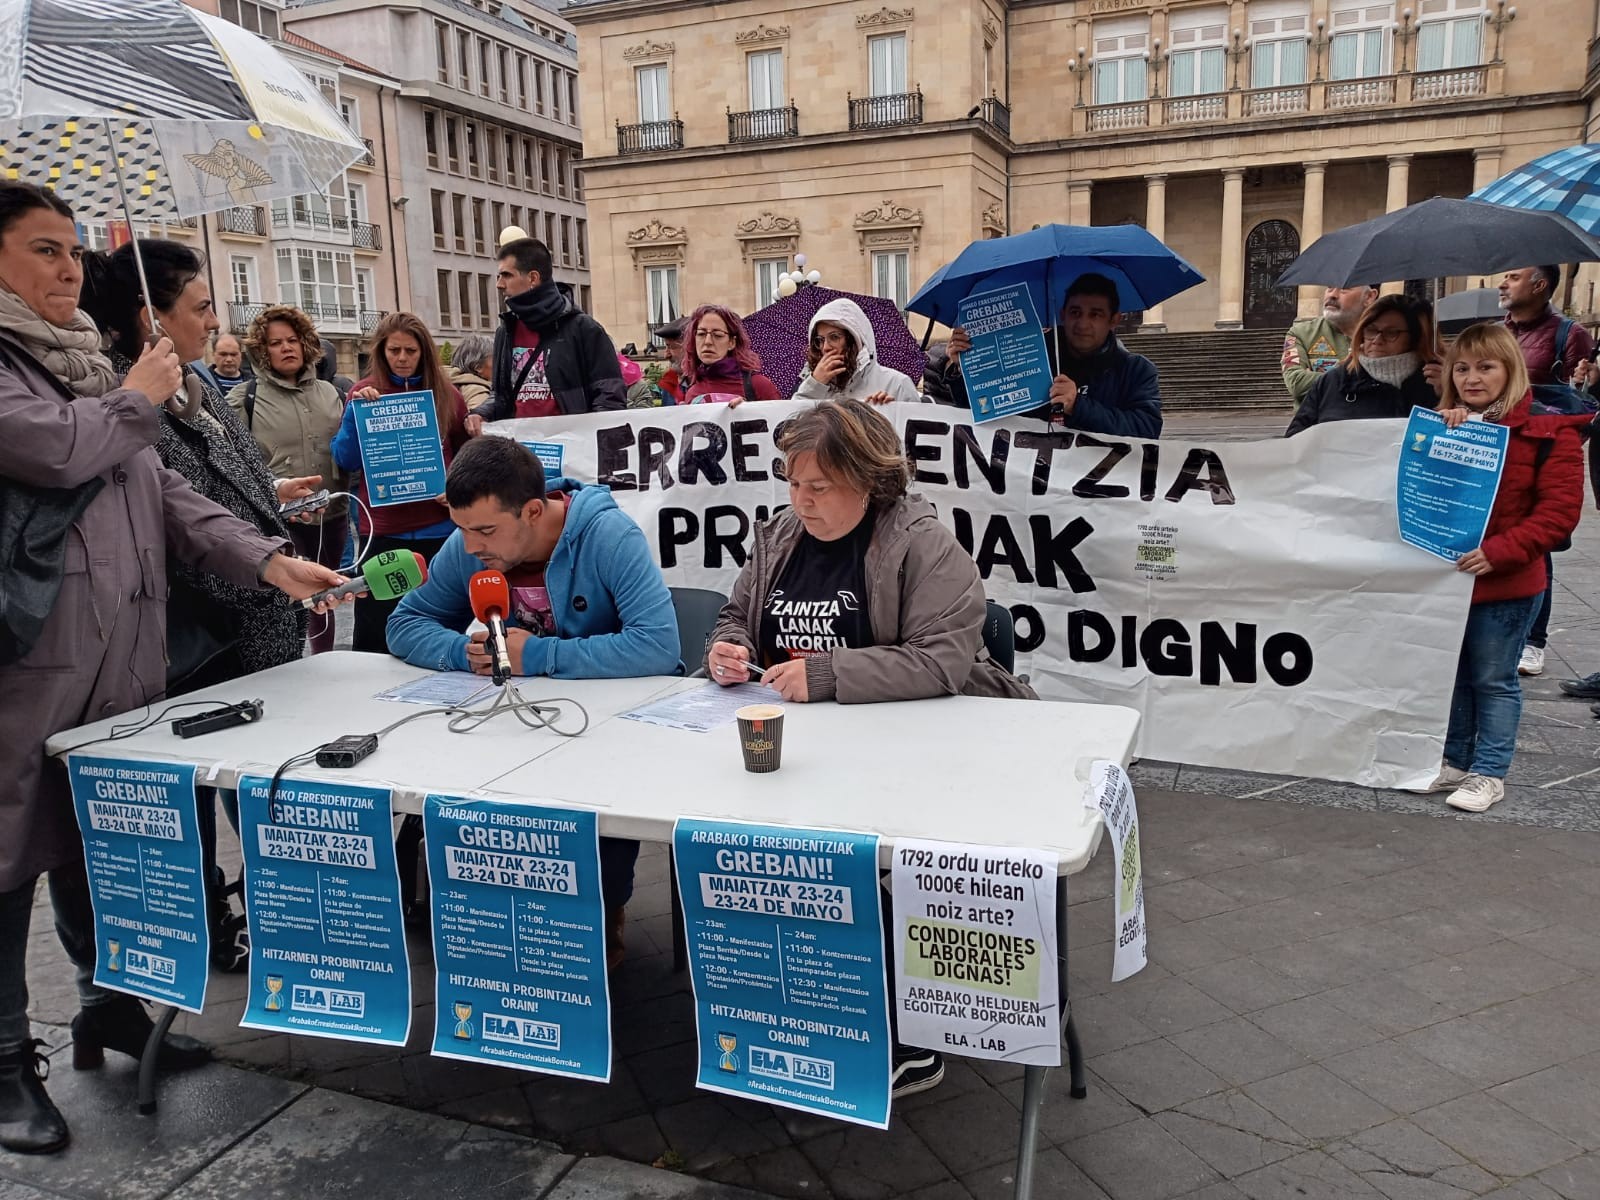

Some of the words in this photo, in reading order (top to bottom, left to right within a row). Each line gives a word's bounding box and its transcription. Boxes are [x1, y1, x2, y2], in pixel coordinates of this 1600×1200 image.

[966, 300, 1014, 320] GREBAN!!
[372, 403, 418, 416] GREBAN!!
[477, 576, 501, 585] rne
[771, 600, 840, 617] ZAINTZA
[779, 617, 835, 635] LANAK
[1068, 609, 1313, 686] DIGNO
[80, 766, 114, 778] ARABAKO
[116, 769, 180, 784] ERRESIDENTZIAK
[96, 780, 168, 805] GREBAN!!
[251, 787, 295, 802] ARAAKO
[298, 792, 374, 810] ERRESIDENTZIAK
[94, 803, 144, 820] MAIATZAK
[147, 810, 176, 824] 23-24
[272, 803, 360, 832] GREBAN!!
[438, 806, 487, 823] ARABAKO
[490, 813, 577, 833] ERRESIDENTZIAK
[98, 818, 125, 832] 23-24
[128, 821, 142, 834] DE
[144, 823, 176, 838] MAYO
[264, 828, 328, 847] MAIATZAK
[332, 836, 368, 852] 23-24
[458, 825, 560, 856] GREBAN!!
[268, 844, 302, 860] 23-24
[307, 848, 324, 862] DE
[328, 850, 366, 867] MAYO
[692, 830, 748, 847] ARABAKO
[753, 836, 854, 856] ERRESIDENTZIAK
[454, 850, 524, 872] MAIATZAK
[529, 860, 569, 877] 23-24
[716, 849, 834, 880] GREBAN!!
[900, 849, 933, 868] 1792
[938, 852, 978, 872] ordu
[984, 858, 1042, 880] urteko
[458, 866, 496, 882] 23-24
[500, 872, 520, 886] DE
[524, 874, 568, 892] MAYO
[709, 876, 792, 898] MAIATZAK
[797, 886, 844, 904] 23-24
[915, 874, 964, 894] 1000€
[970, 877, 1024, 901] hilean
[714, 894, 758, 912] 23-24
[764, 899, 786, 914] DE
[791, 902, 842, 920] MAYO
[926, 900, 962, 920] noiz
[968, 906, 1014, 926] arte?
[102, 914, 142, 931] HITZARMEN
[144, 923, 197, 943] PROBINTZIALA
[795, 930, 816, 940] 24an:
[908, 924, 1036, 955] CONDICIONES
[128, 952, 149, 970] ELA
[153, 960, 172, 975] LAB
[263, 948, 318, 964] HITZARMEN
[322, 955, 394, 974] PROBINTZIALA
[920, 942, 1025, 970] LABORALES
[310, 968, 344, 982] ORAIN!
[934, 960, 1010, 986] DIGNAS!
[295, 988, 326, 1006] ELA
[331, 994, 360, 1009] LAB
[450, 974, 510, 993] HITZARMEN
[513, 984, 592, 1006] PROBINTZIALA
[908, 986, 971, 1005] ARABAKO
[976, 994, 1040, 1013] HELDUEN
[501, 997, 538, 1013] ORAIN!
[904, 999, 966, 1018] EGOITZAK
[972, 1008, 1046, 1028] BORROKAN
[485, 1016, 520, 1037] ELA
[525, 1024, 556, 1041] LAB
[710, 1004, 777, 1026] HITZARMEN
[781, 1016, 870, 1042] PROBINTZIALA
[768, 1030, 810, 1048] ORAIN!
[944, 1032, 968, 1046] ELA
[980, 1038, 1006, 1052] LAB
[752, 1050, 788, 1073] ELA
[794, 1060, 830, 1079] LAB
